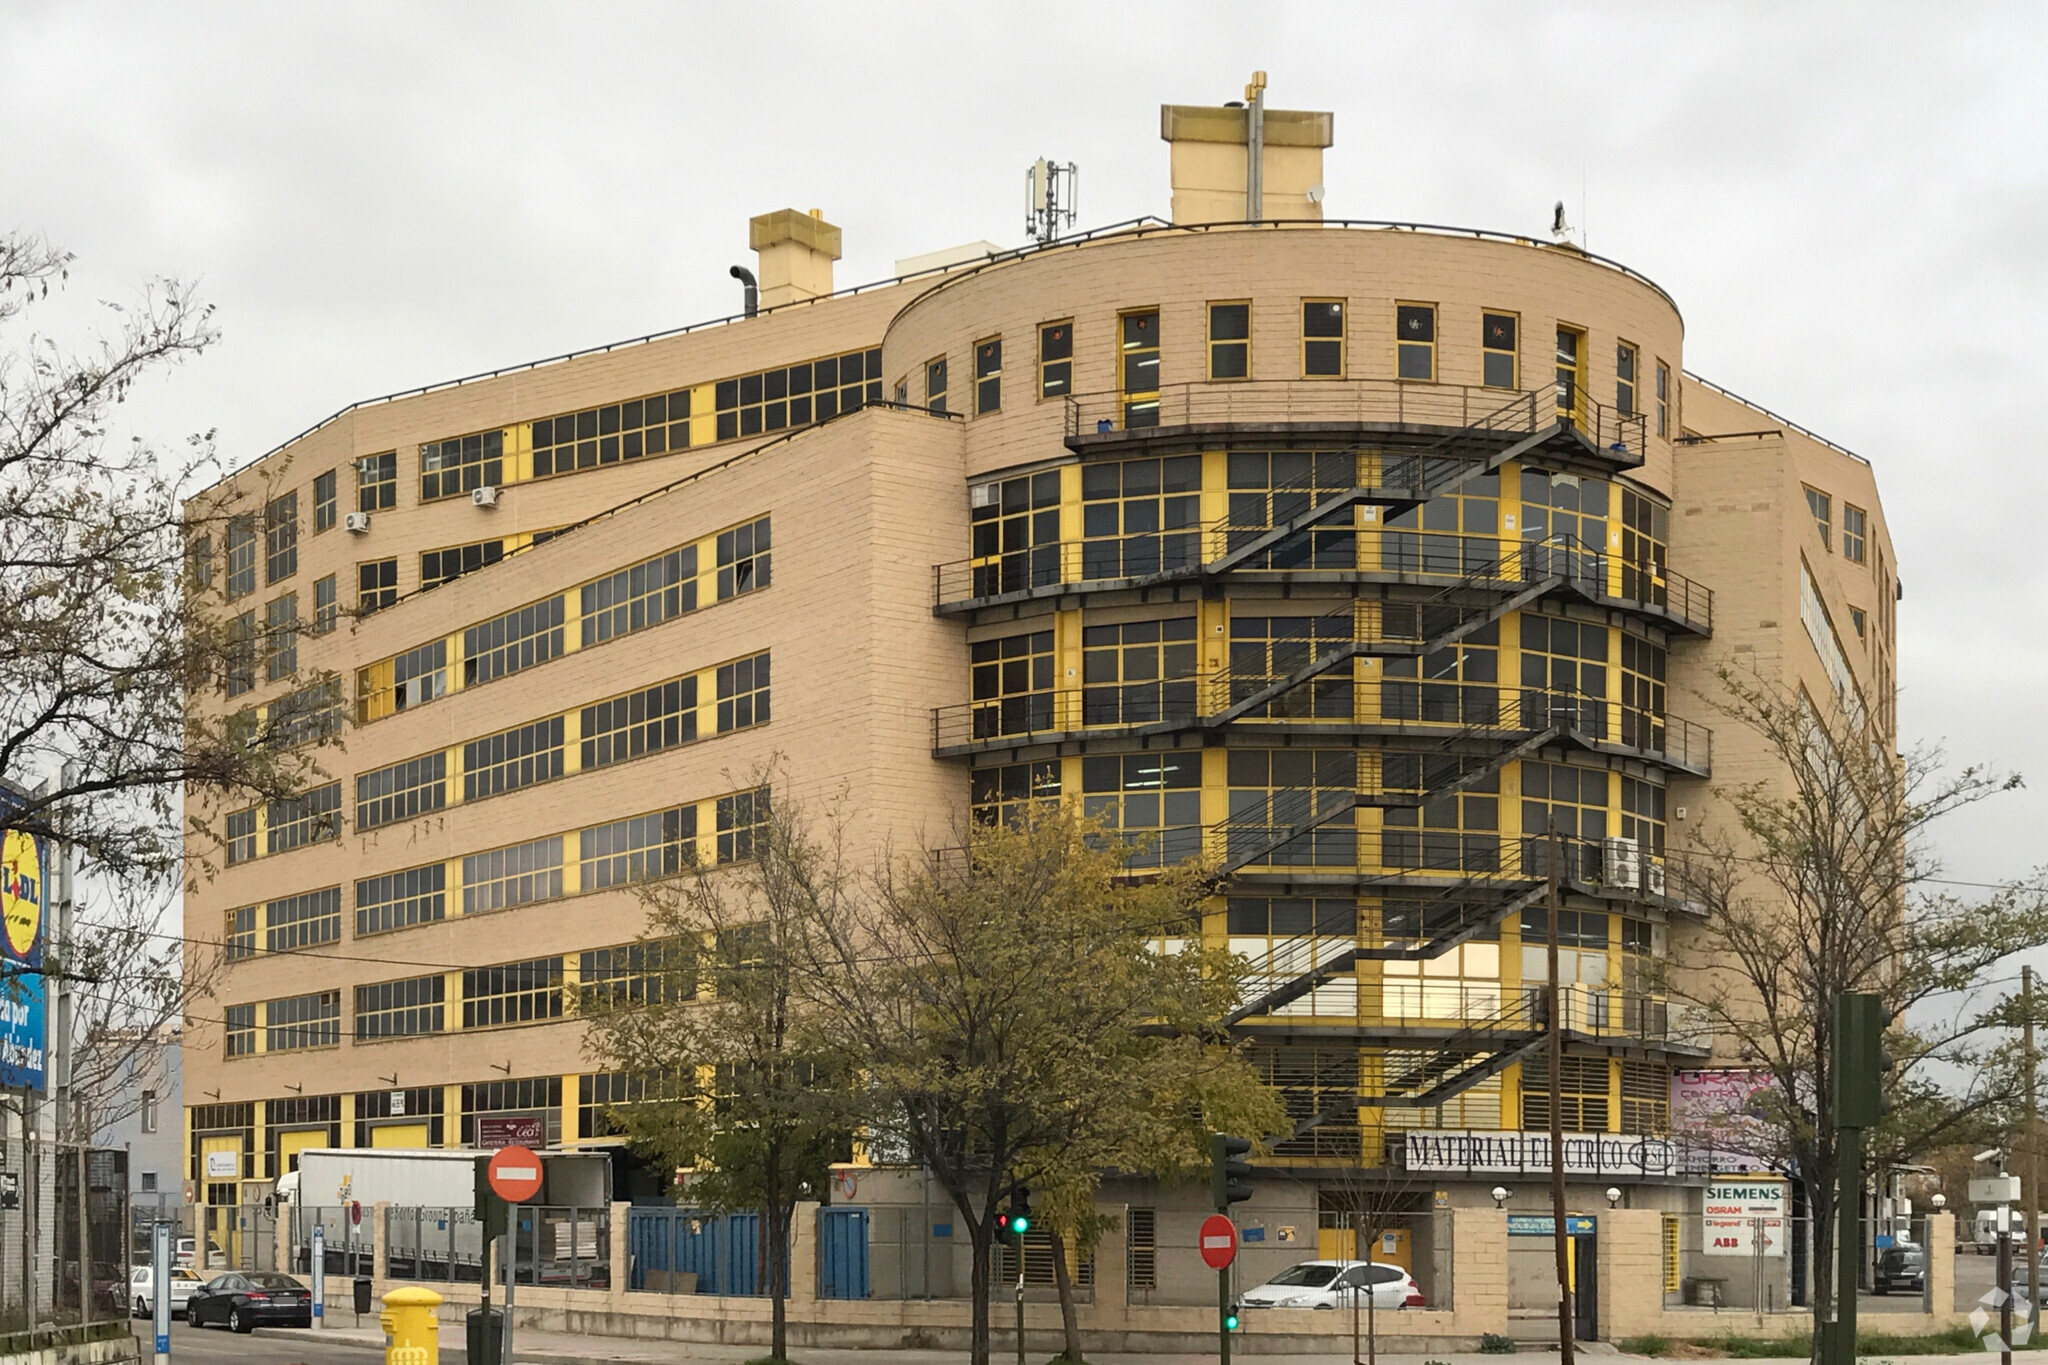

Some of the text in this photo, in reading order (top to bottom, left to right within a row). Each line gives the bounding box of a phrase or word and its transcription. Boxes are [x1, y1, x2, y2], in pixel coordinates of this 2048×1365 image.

[11, 1000, 30, 1034] por
[1680, 1089, 1740, 1098] CENTRO
[1409, 1135, 1623, 1170] MATERIAL ELCTRCO
[1706, 1187, 1780, 1200] SIEMENS
[1706, 1206, 1742, 1215] OSRAM
[1713, 1237, 1739, 1248] ABB
